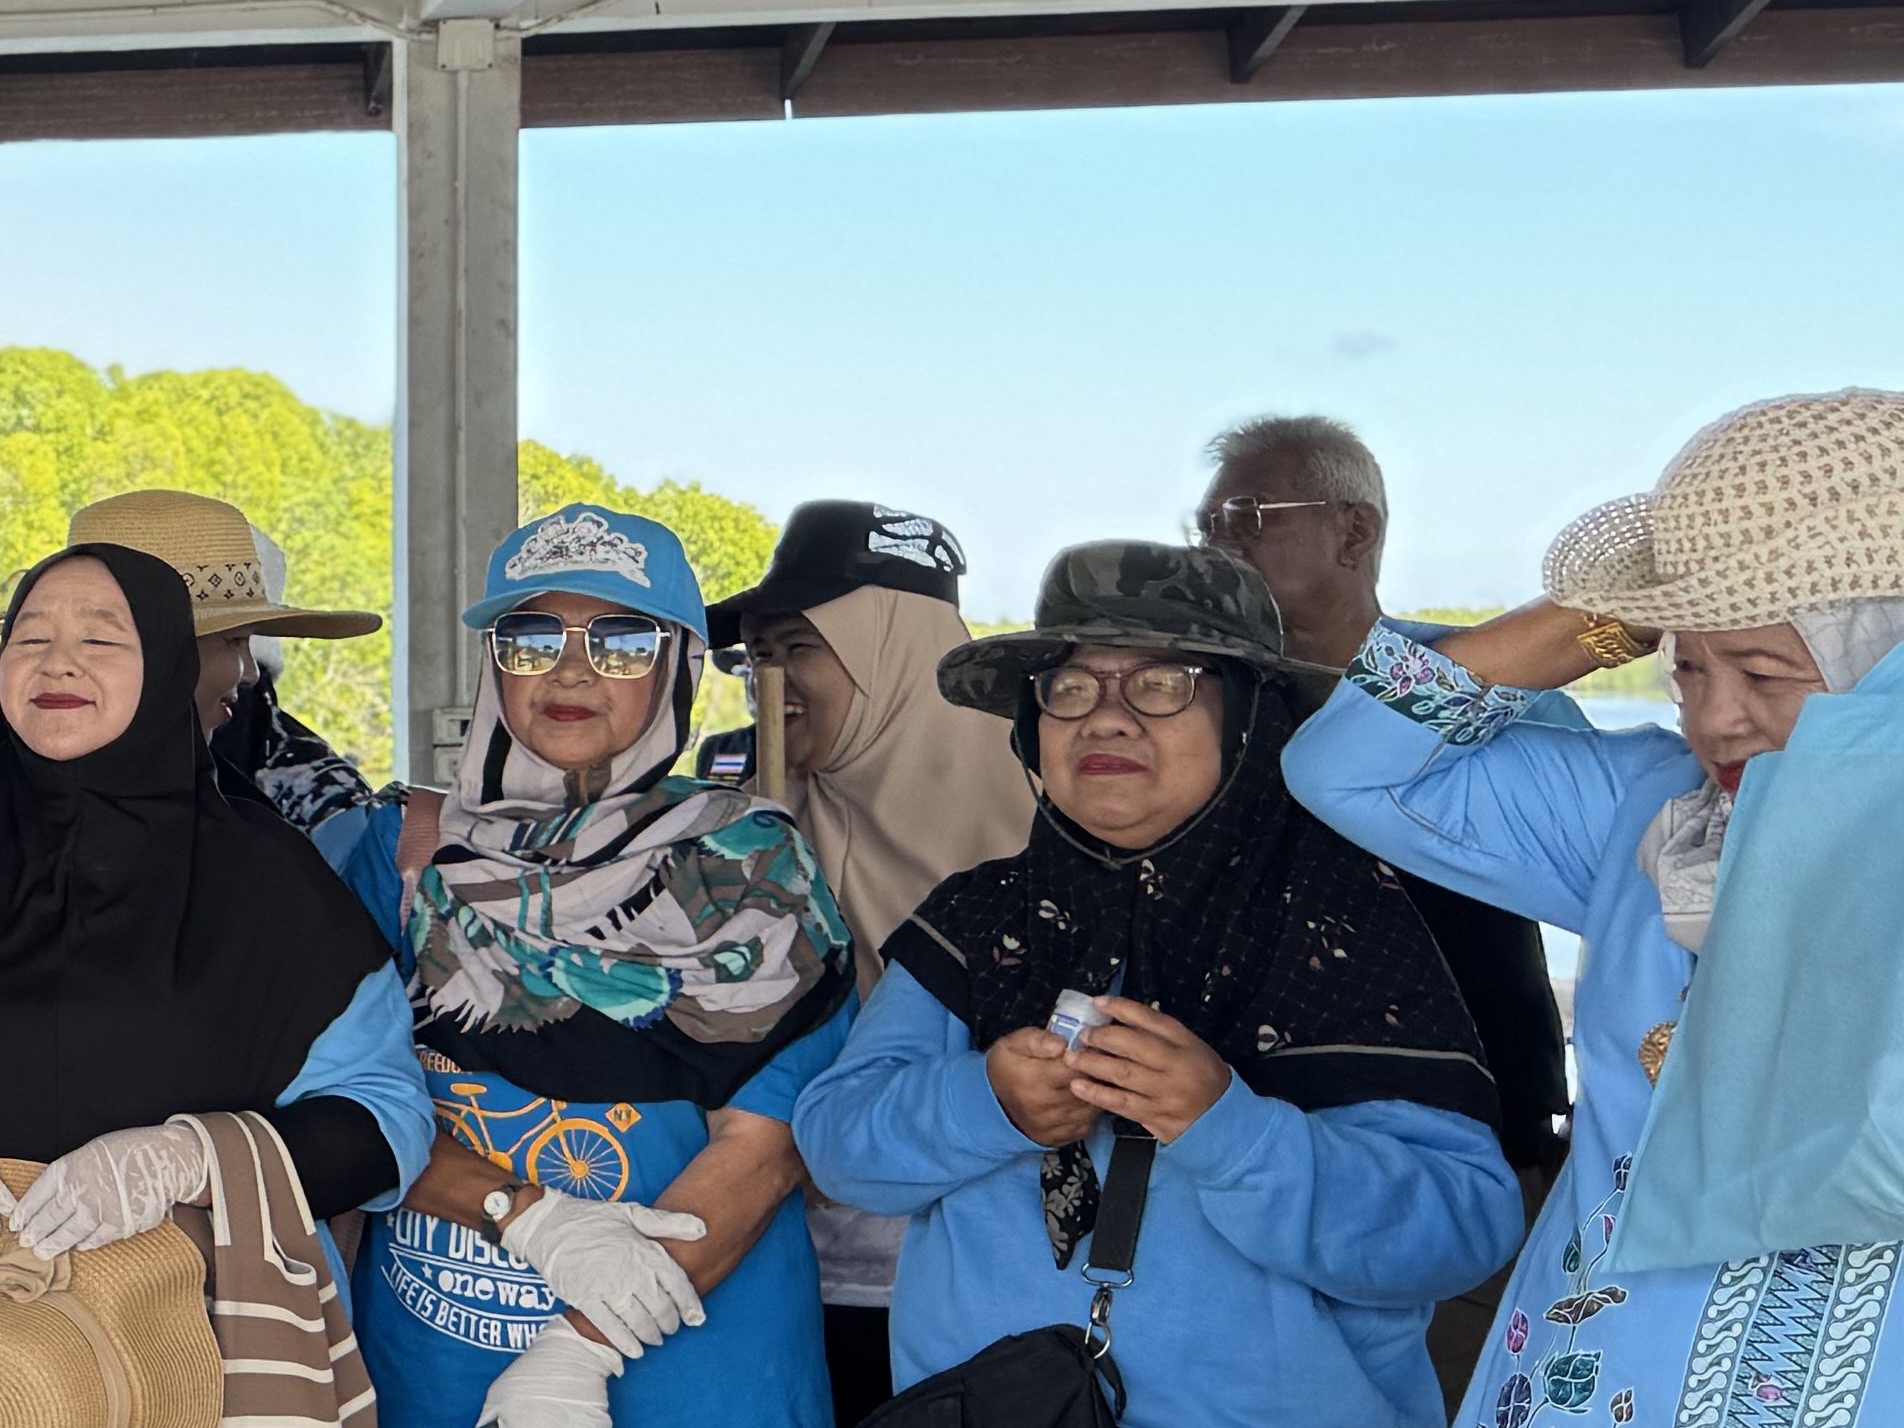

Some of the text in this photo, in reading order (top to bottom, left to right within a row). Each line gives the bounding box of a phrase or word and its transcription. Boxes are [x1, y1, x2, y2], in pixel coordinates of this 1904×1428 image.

[395, 1207, 440, 1253] CITY
[389, 1262, 546, 1349] LIFE IS BETTER WH
[438, 1269, 556, 1311] one way
